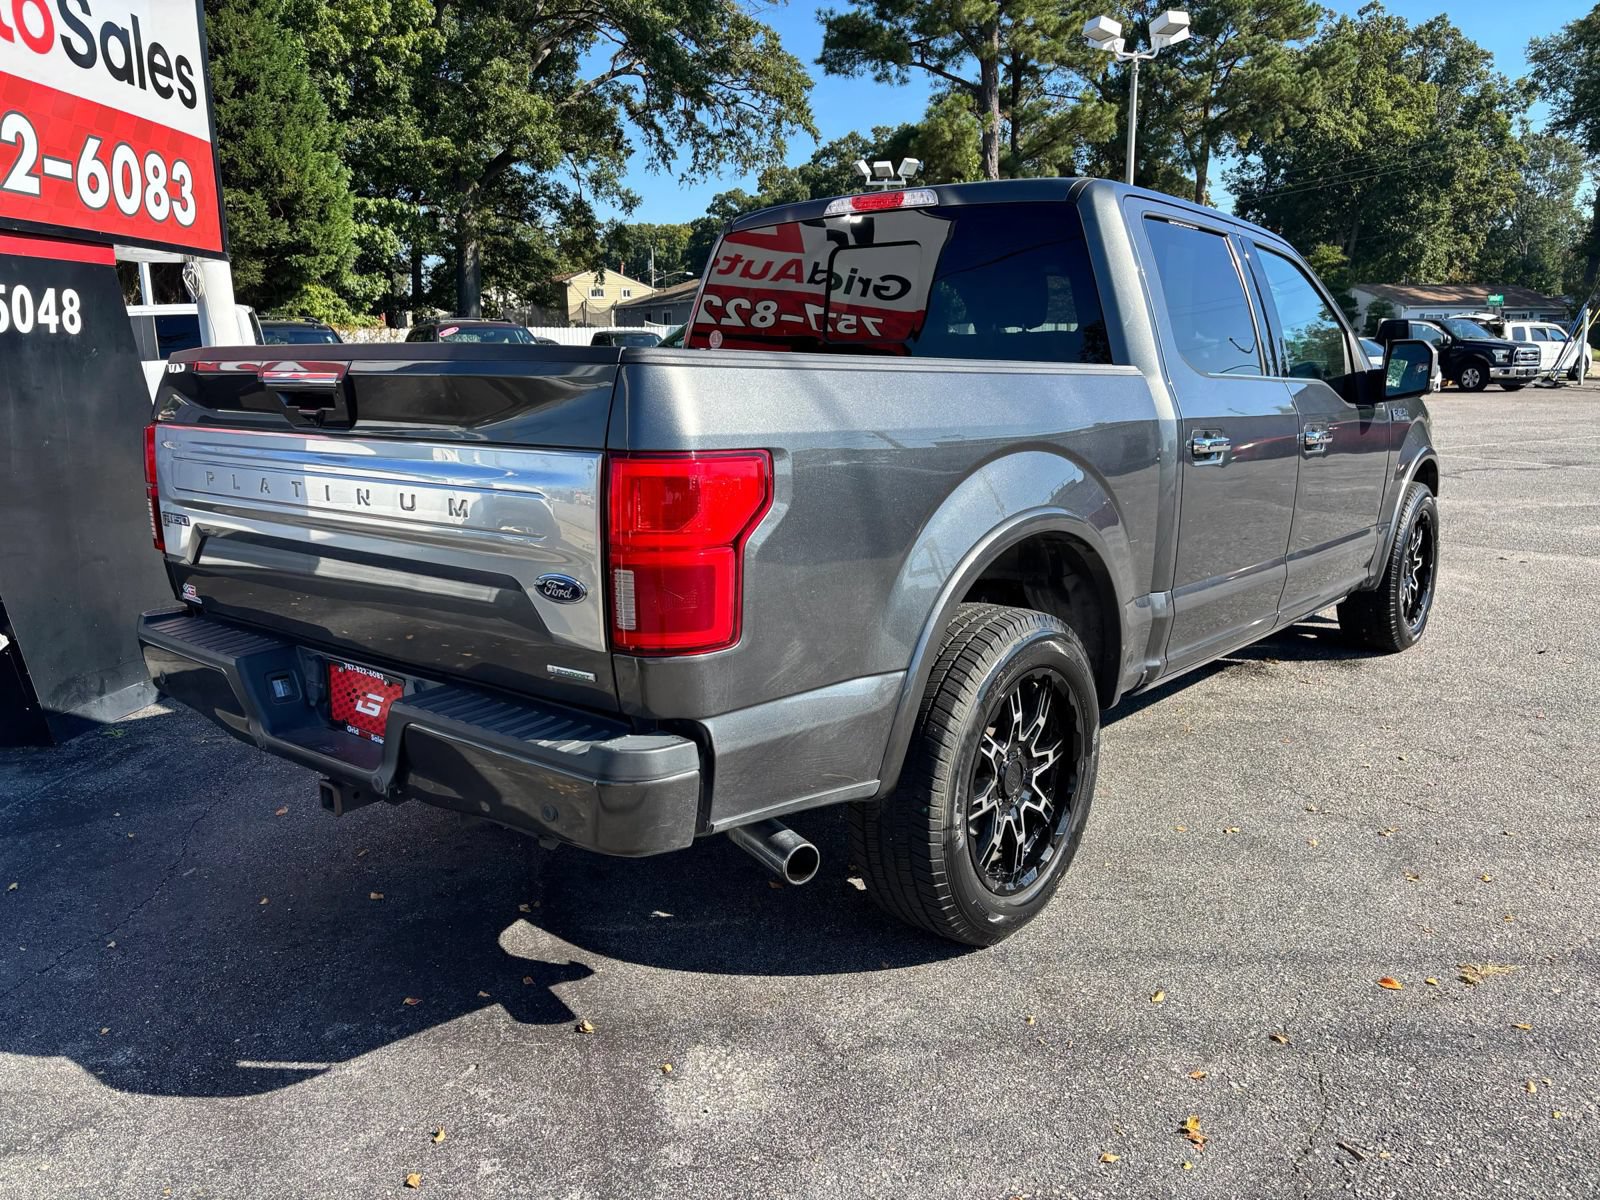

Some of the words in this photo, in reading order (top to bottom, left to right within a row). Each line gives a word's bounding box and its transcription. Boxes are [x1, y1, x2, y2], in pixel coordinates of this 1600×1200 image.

[0, 110, 197, 228] 2-6083
[205, 471, 469, 518] PLATINUM
[544, 580, 573, 599] Ford
[344, 663, 383, 679] 757-822-6083
